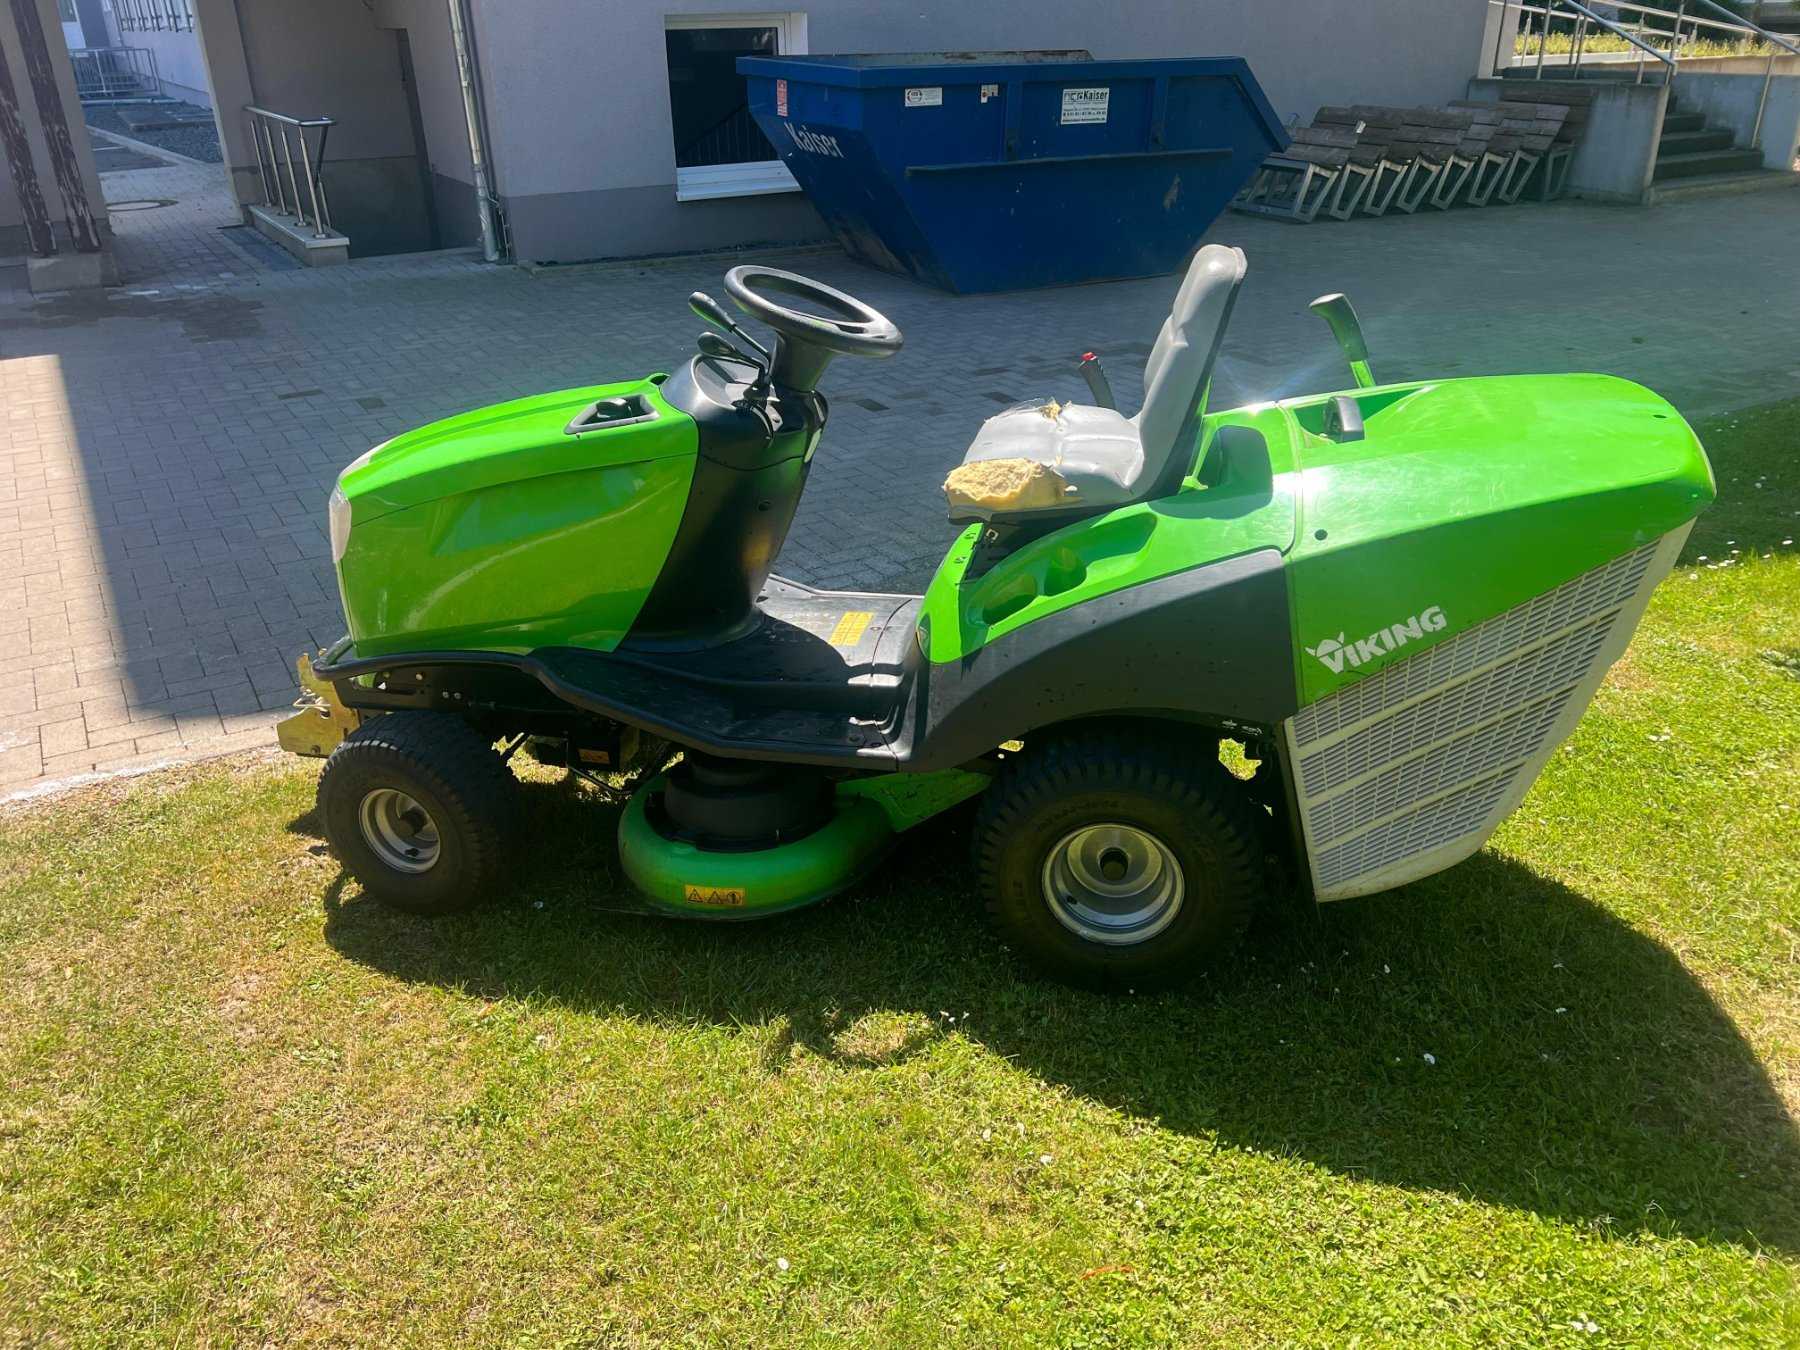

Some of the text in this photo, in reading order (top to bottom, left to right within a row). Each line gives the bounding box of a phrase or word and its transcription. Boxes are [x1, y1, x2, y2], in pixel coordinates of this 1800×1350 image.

[1083, 90, 1108, 101] Kaiser
[784, 121, 844, 158] Kaiser
[1318, 605, 1447, 674] VIKING
